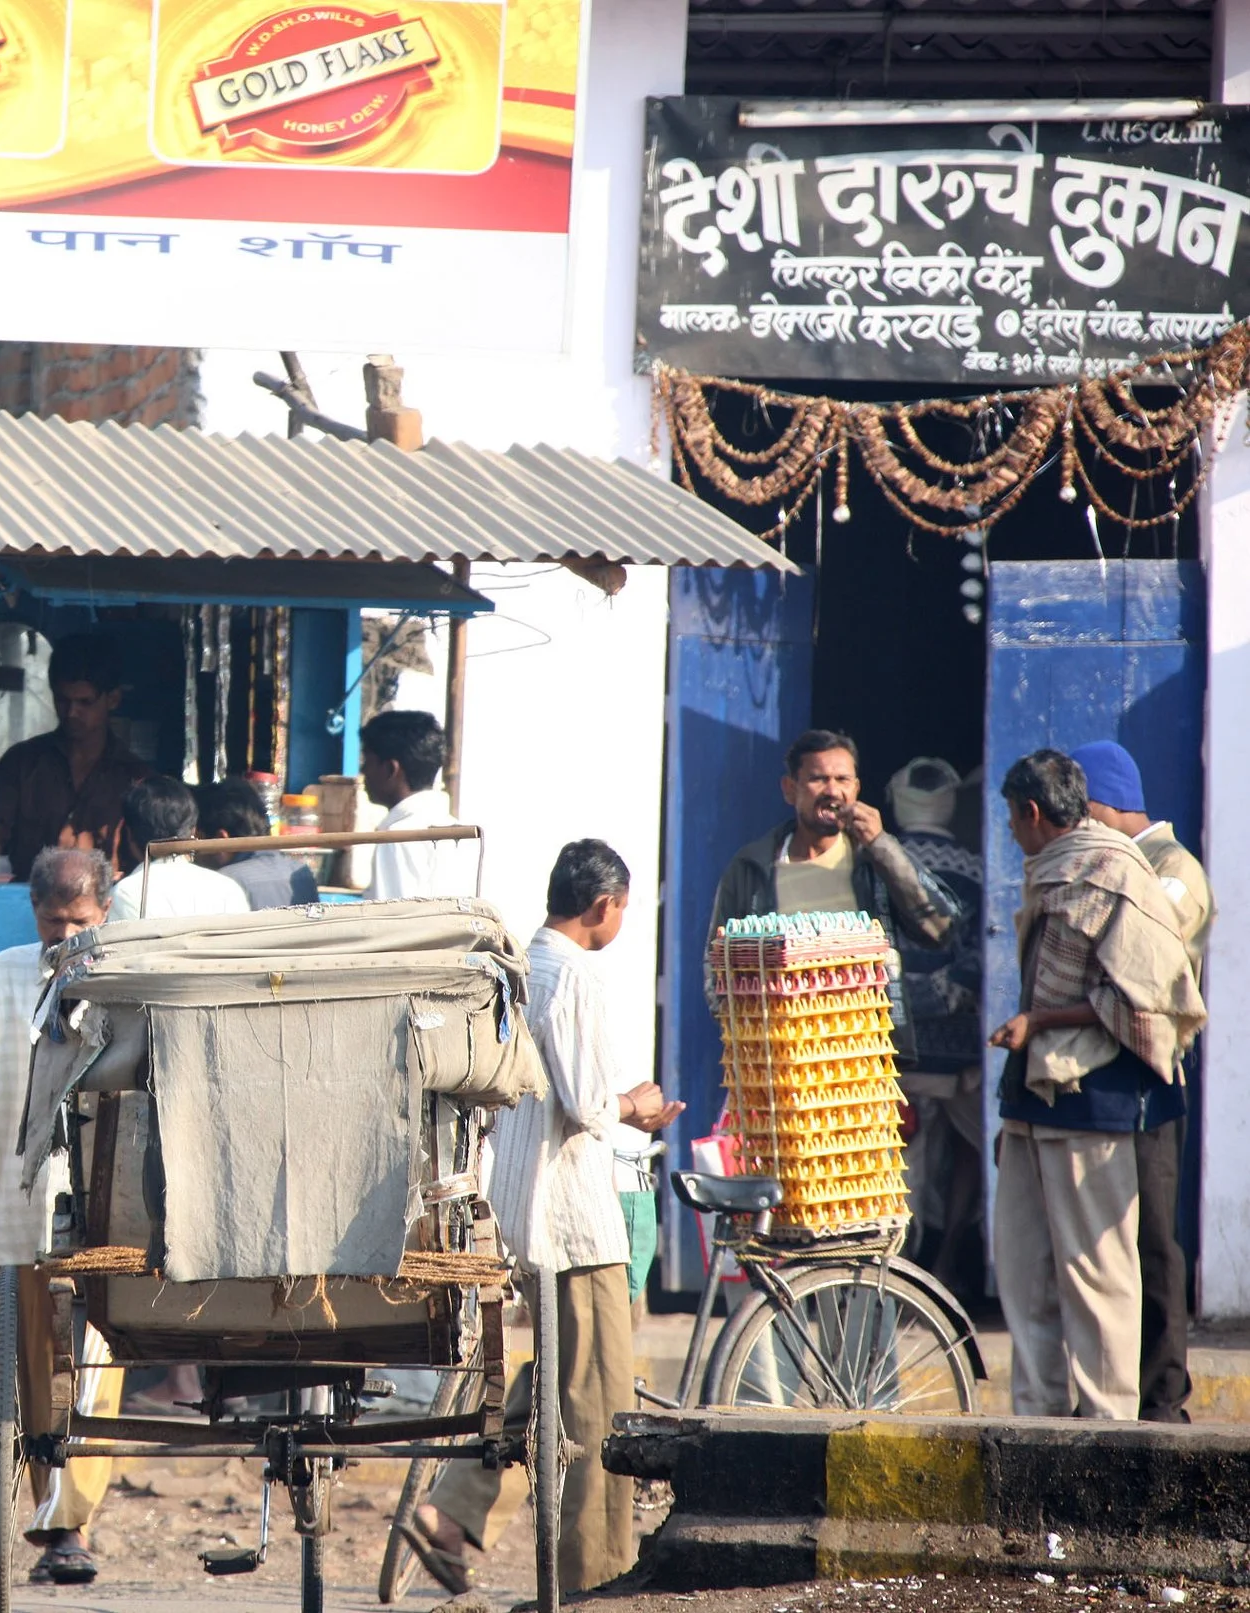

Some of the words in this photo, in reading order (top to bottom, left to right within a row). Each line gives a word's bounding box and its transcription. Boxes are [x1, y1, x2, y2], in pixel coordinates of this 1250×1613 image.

[247, 11, 366, 56] W.D.&H.O.WILLS
[218, 60, 308, 107] GOLD
[317, 30, 415, 81] FLAKE
[283, 119, 347, 133] HONEY
[659, 143, 805, 278] देशी
[1050, 156, 1250, 288] दुकान
[27, 230, 179, 253] पान
[237, 233, 403, 264] शॉप
[882, 241, 976, 297] विक्री
